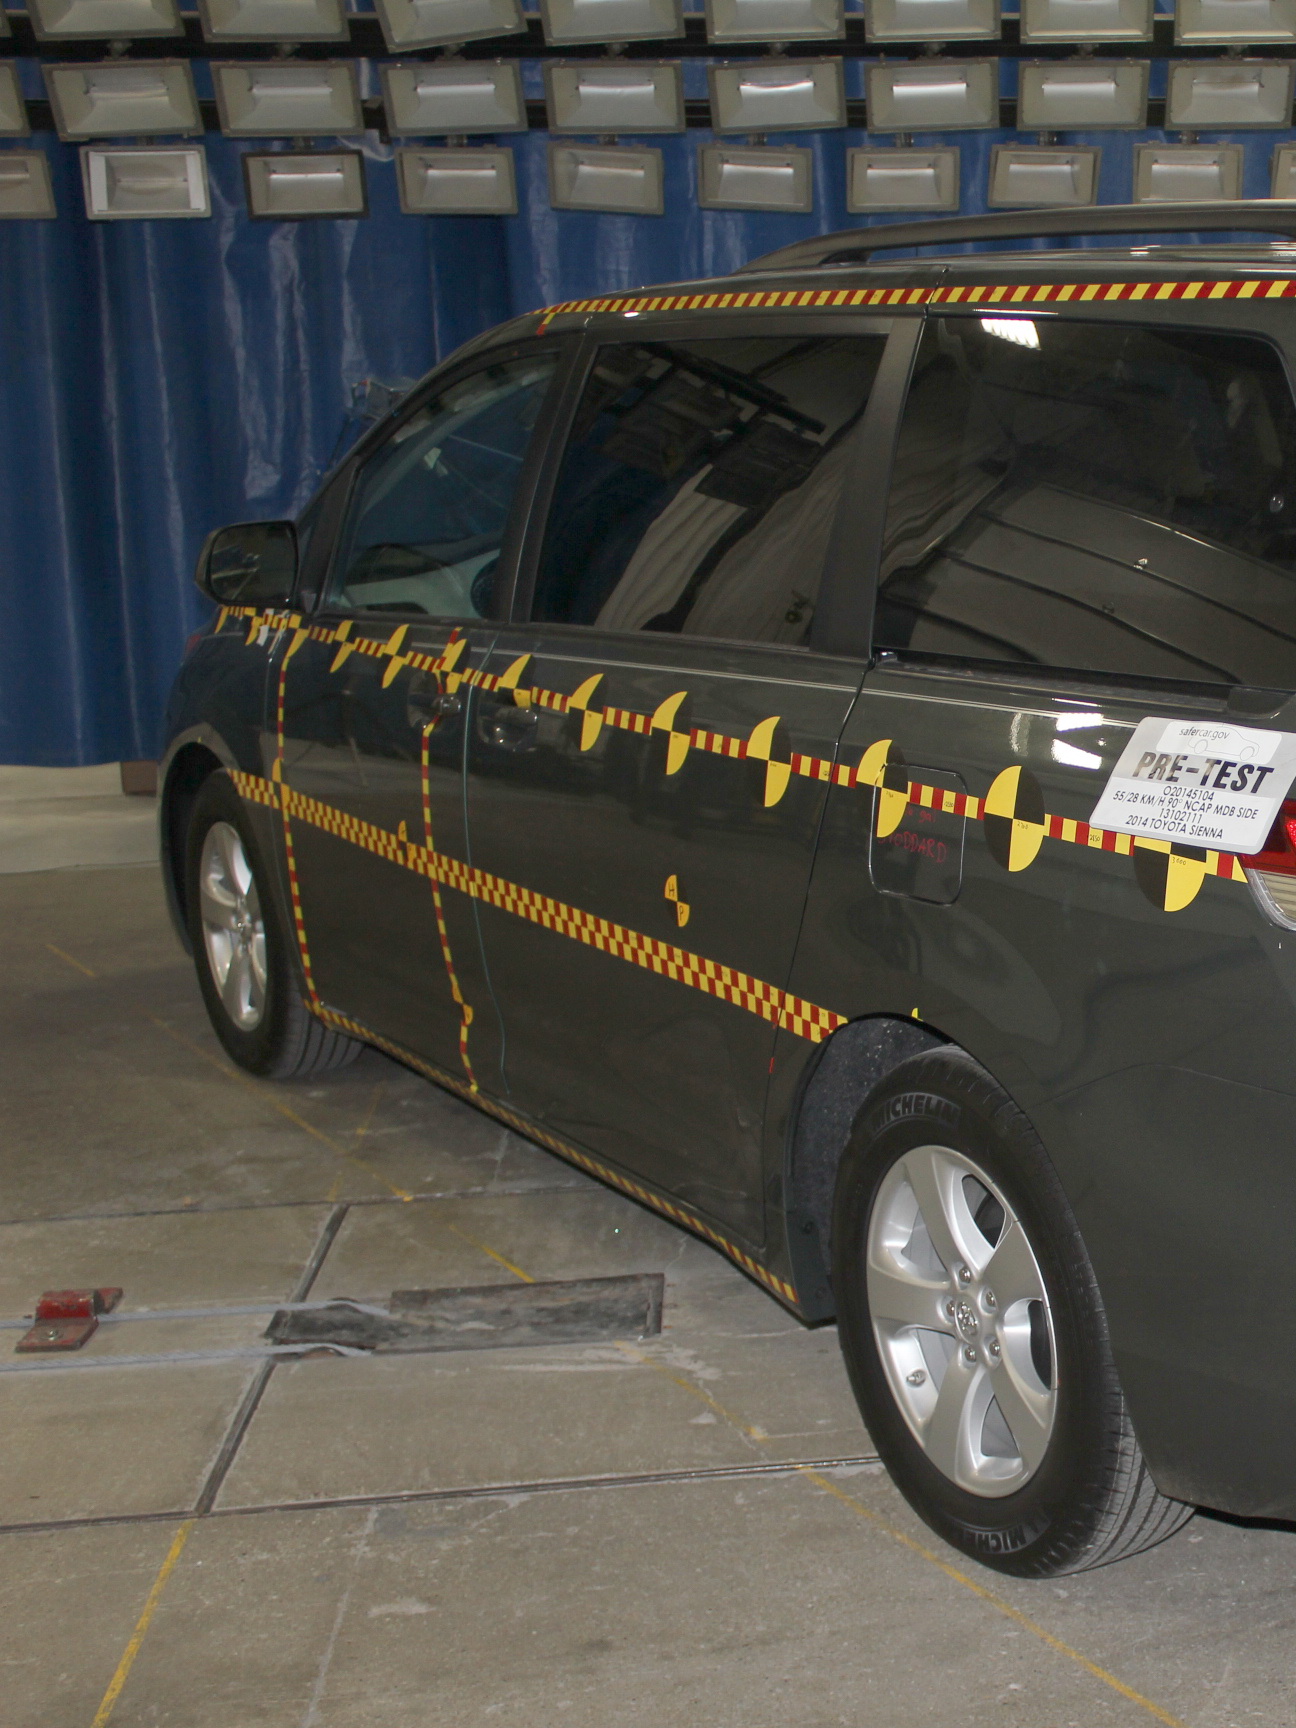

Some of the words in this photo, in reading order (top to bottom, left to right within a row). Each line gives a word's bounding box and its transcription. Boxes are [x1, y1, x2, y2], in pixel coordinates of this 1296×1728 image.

[1179, 726, 1230, 740] safercar.gov
[1132, 751, 1275, 793] PRE-TEST
[1113, 790, 1139, 803] 55/28
[1140, 793, 1166, 807] KM/H
[1183, 800, 1213, 813] NCAP
[1213, 804, 1236, 816] MDB
[1237, 807, 1259, 819] SIDE
[1160, 808, 1203, 824] 13102111
[1125, 815, 1149, 828] 2014
[1150, 818, 1187, 834] TOYOTA
[1189, 824, 1224, 840] SIENNA
